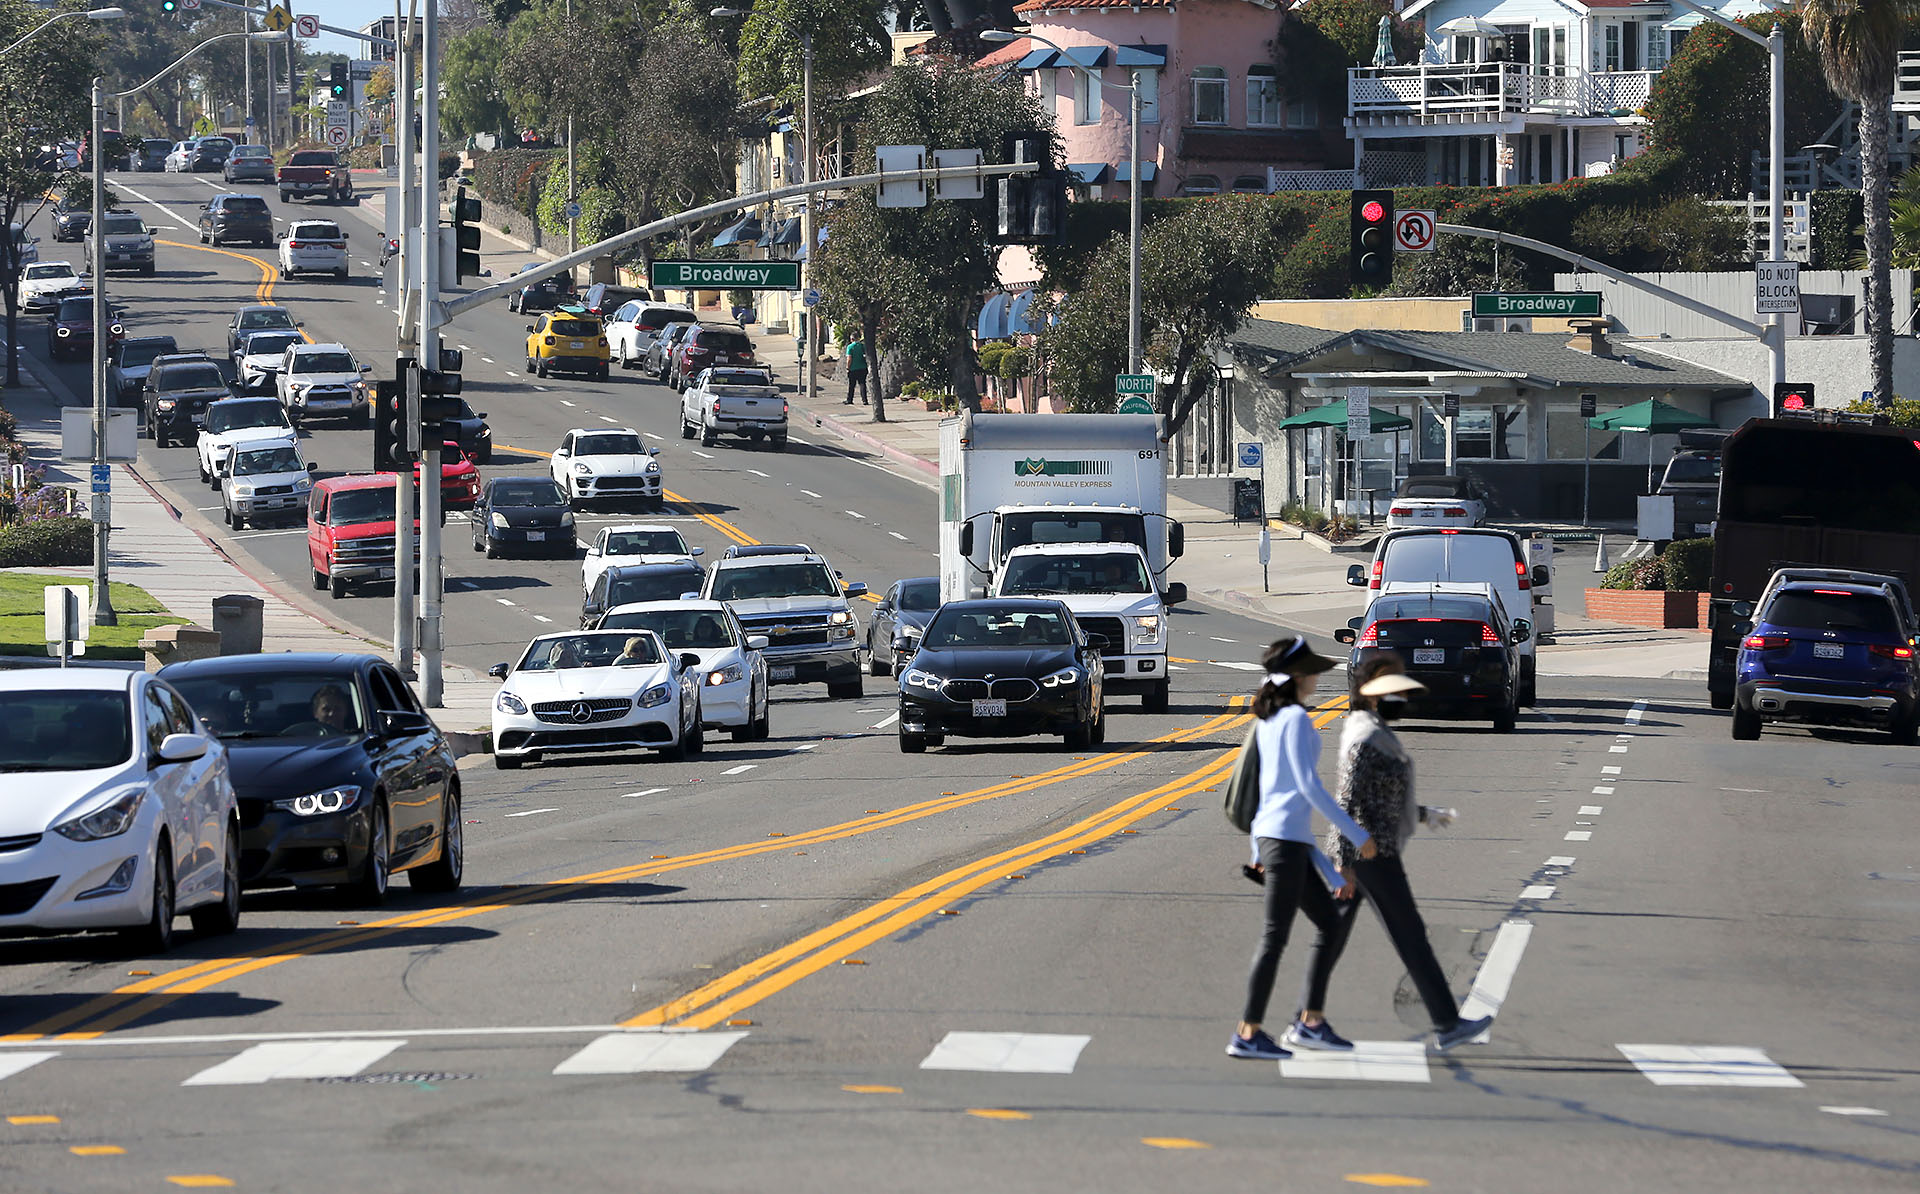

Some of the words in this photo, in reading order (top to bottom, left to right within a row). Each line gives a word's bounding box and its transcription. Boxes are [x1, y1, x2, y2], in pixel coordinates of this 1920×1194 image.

[680, 265, 770, 285] Broadway
[1760, 268, 1773, 281] DO
[1776, 268, 1796, 281] NOT
[1759, 285, 1797, 298] BLOCK
[1498, 296, 1576, 313] Broadway
[1759, 299, 1797, 309] INTERSECTION
[1118, 378, 1153, 391] NORTH
[1138, 449, 1160, 460] 691
[1014, 480, 1051, 488] MOUNTAIN
[1053, 480, 1079, 488] VALLEY
[1080, 480, 1112, 488] EXPRESS
